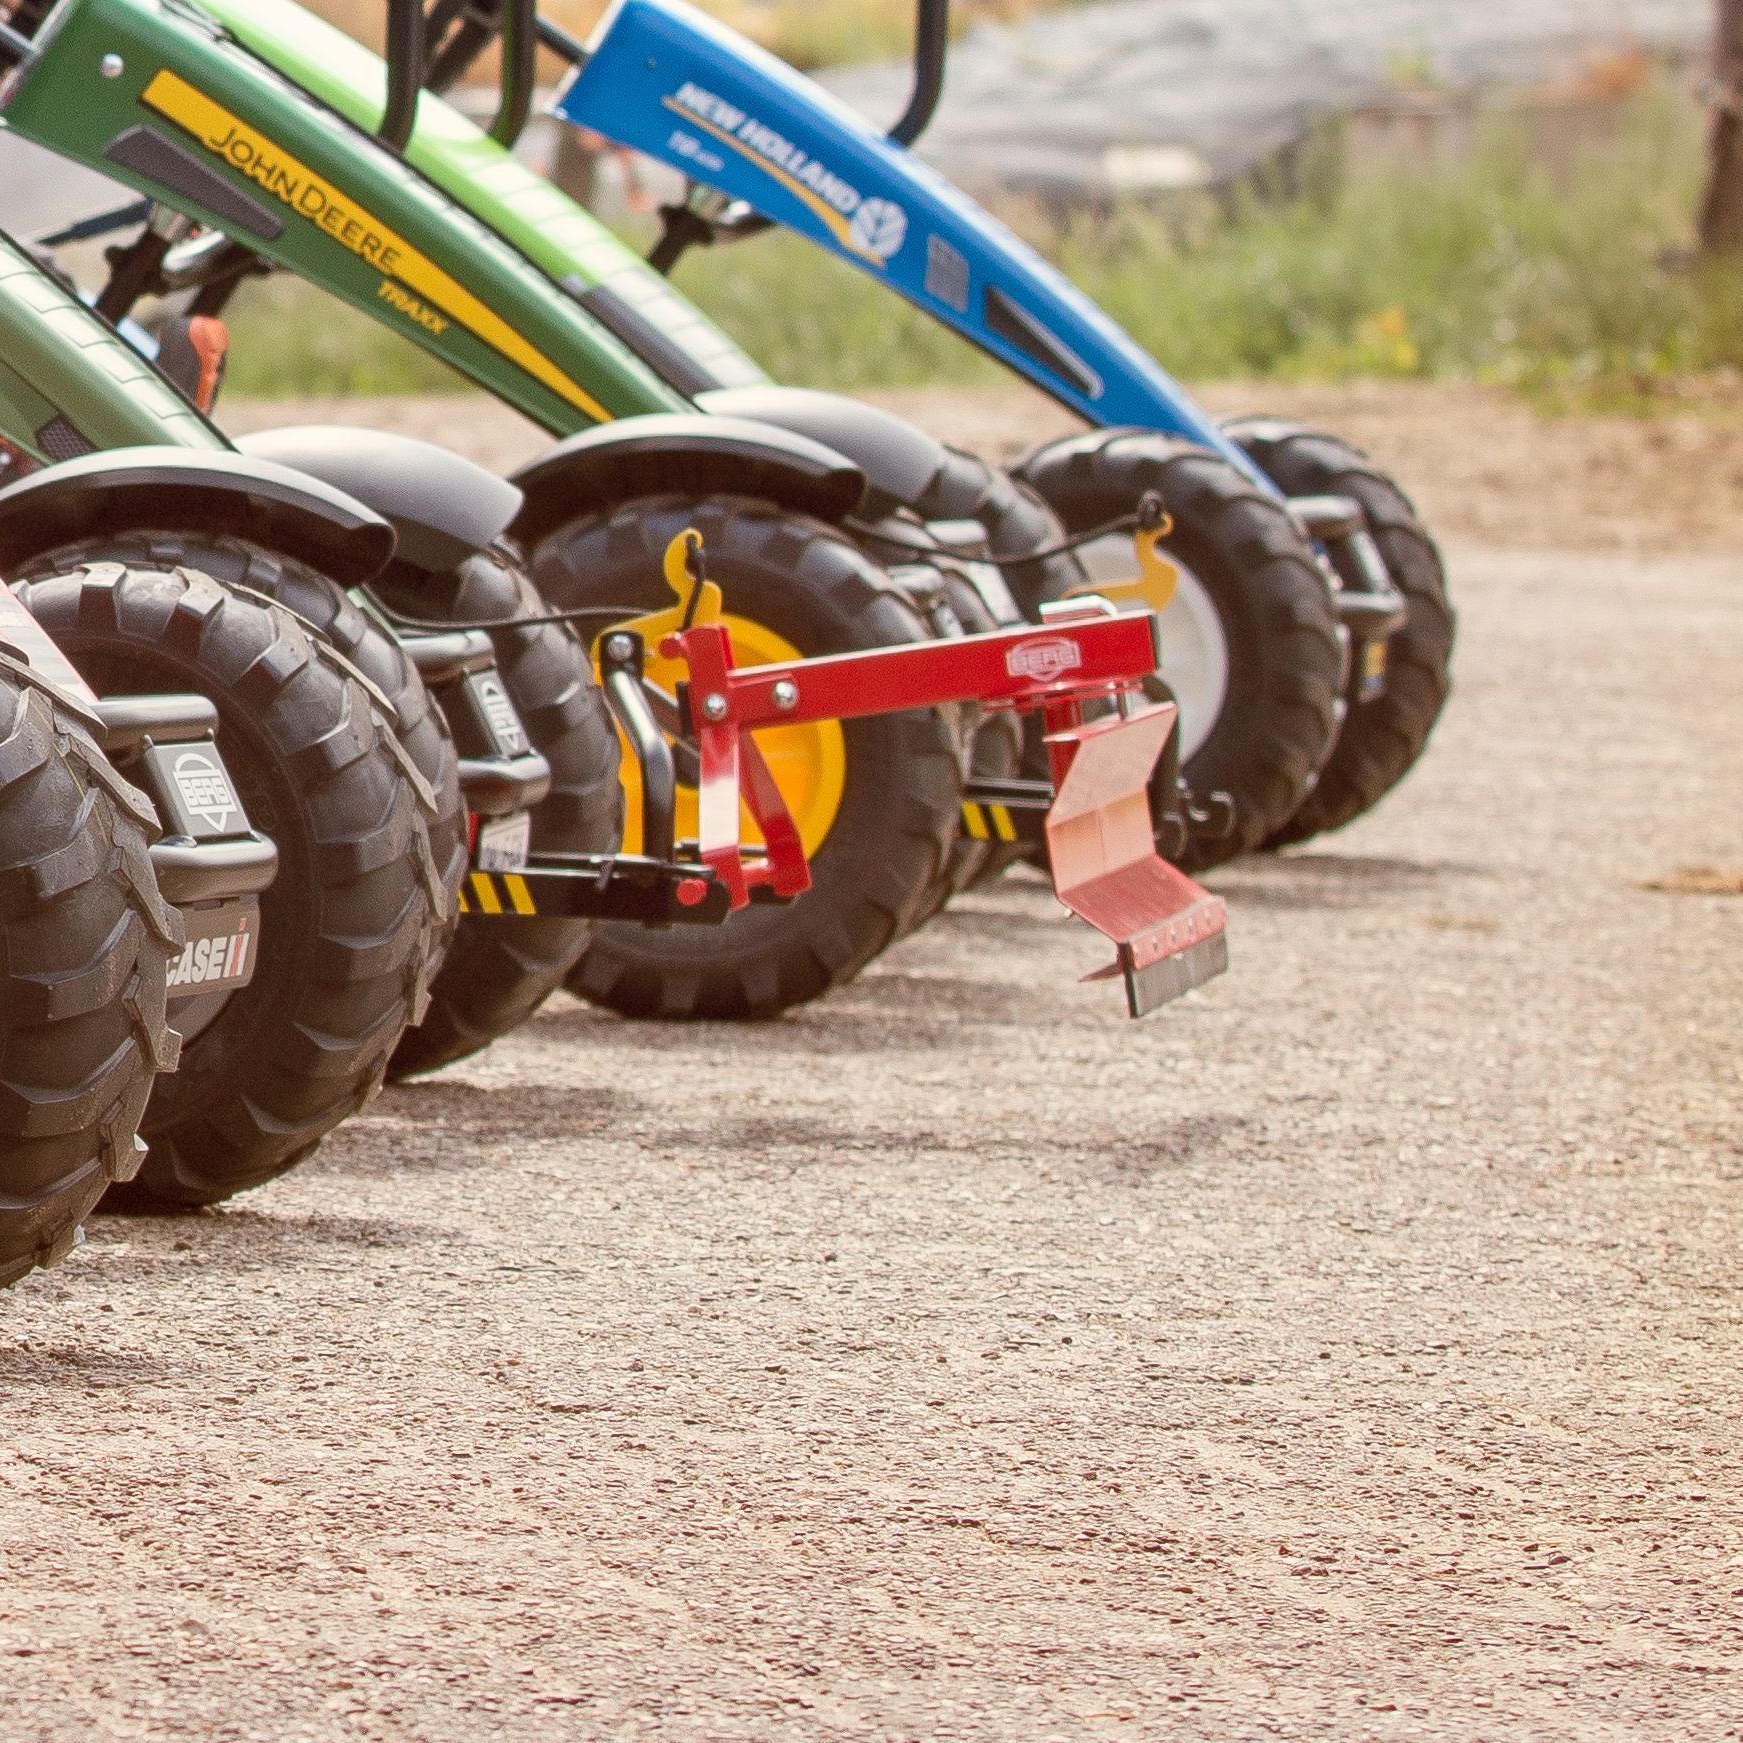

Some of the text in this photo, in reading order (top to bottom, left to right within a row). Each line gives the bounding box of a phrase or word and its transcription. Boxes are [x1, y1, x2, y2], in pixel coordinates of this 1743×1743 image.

[210, 126, 402, 272] JOHN DEERE
[675, 81, 748, 132] NEW
[736, 118, 863, 215] HOLLAND
[179, 776, 231, 807] BERG
